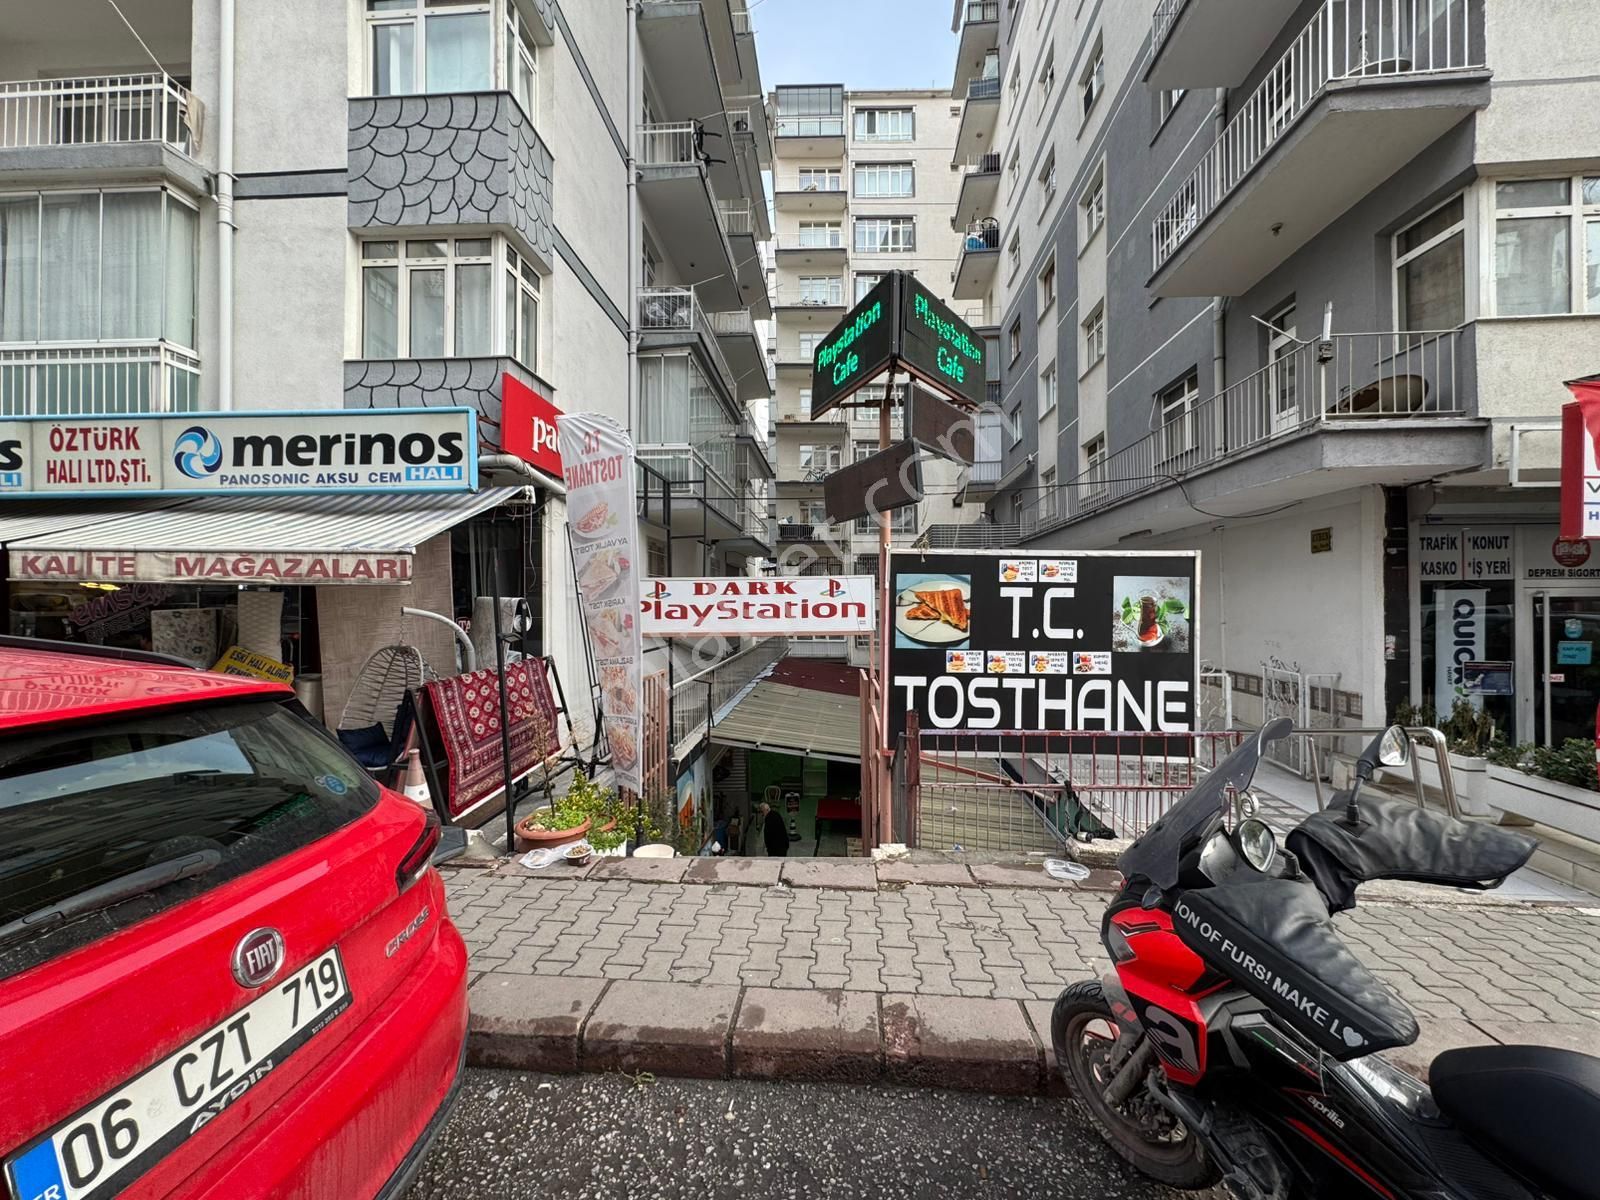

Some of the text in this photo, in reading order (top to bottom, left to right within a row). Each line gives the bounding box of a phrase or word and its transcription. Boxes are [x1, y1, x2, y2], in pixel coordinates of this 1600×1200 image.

[818, 301, 881, 372] Playstation
[915, 293, 981, 364] Playstation
[833, 351, 859, 385] Cafe
[937, 346, 965, 383] Cafe
[50, 424, 141, 452] ÖZTÜRK
[232, 432, 463, 467] merinos
[47, 459, 82, 484] HALI
[220, 472, 402, 485] PANOSONIC AKSU CEM
[410, 467, 459, 480] HALI
[1419, 533, 1458, 551] TRAFİK
[1472, 535, 1510, 550] KONUT
[21, 552, 408, 579] KALİTE MAĞAZALARI
[1420, 561, 1457, 575] KASKO
[1486, 557, 1511, 575] YERİ
[1528, 568, 1565, 577] DEPREM
[693, 581, 798, 596] DARK
[1000, 587, 1084, 639] T.C.
[894, 675, 1190, 732] TOSTHANE
[246, 938, 276, 975] FIAT
[1174, 900, 1201, 929] ION
[1200, 922, 1223, 943] OF
[1221, 939, 1273, 985] FURS!
[1272, 976, 1330, 1027] MAKE
[61, 957, 340, 1190] 06 CZT 719
[190, 1059, 274, 1135] AYDIN
[1307, 1095, 1345, 1129] aprilia
